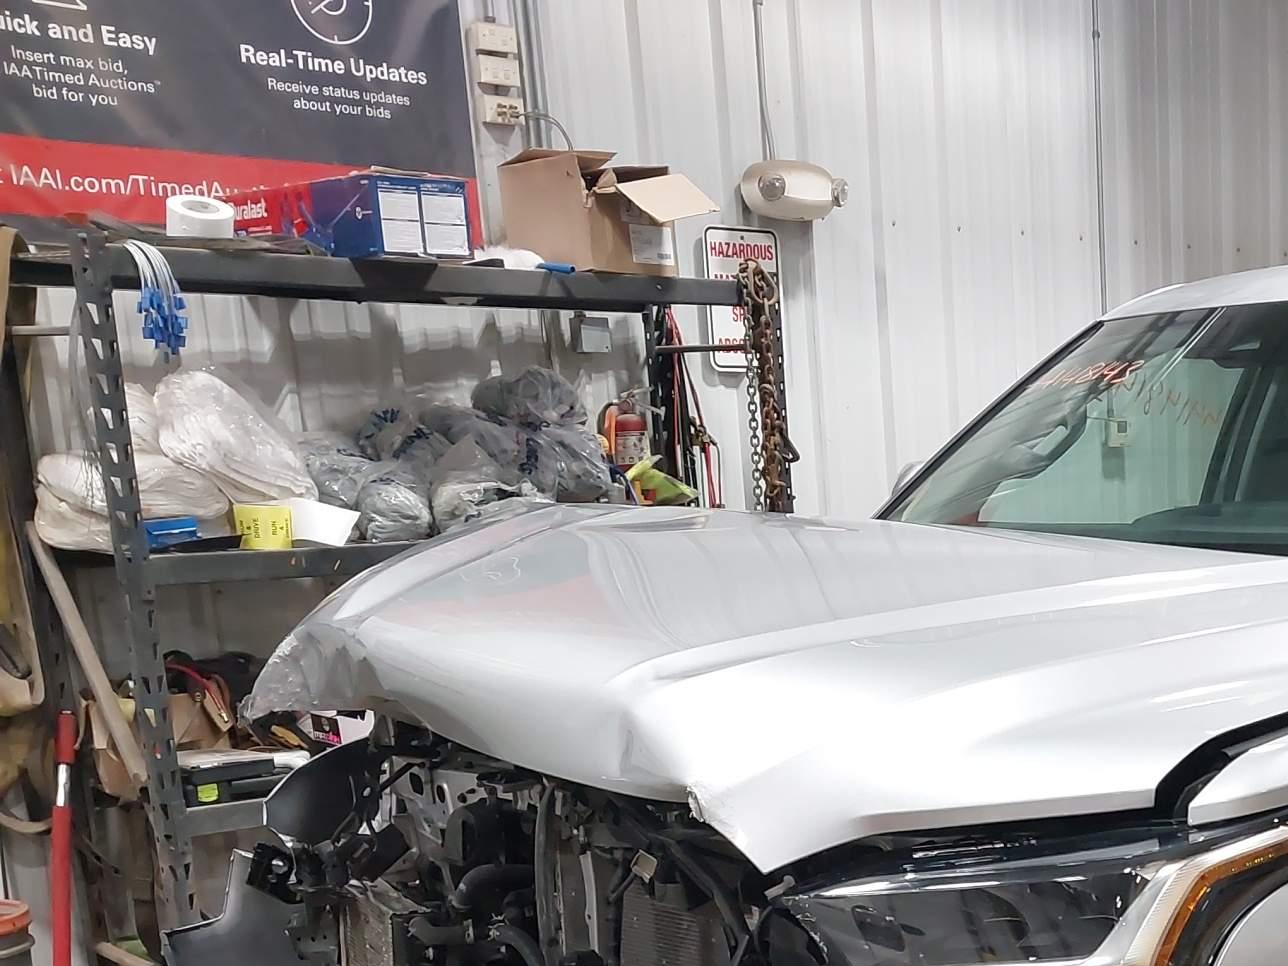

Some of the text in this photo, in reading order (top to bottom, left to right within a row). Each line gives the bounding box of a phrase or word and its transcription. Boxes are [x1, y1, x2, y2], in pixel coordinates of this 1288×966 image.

[48, 23, 95, 44] and
[101, 25, 157, 56] Easy
[11, 45, 128, 75] Insert max bid,
[239, 44, 428, 85] Real-Time Updates
[32, 83, 118, 107] bid for you
[267, 78, 410, 106] Receive status updates
[293, 97, 392, 119] about your bids
[710, 241, 774, 261] HAZARDOUS
